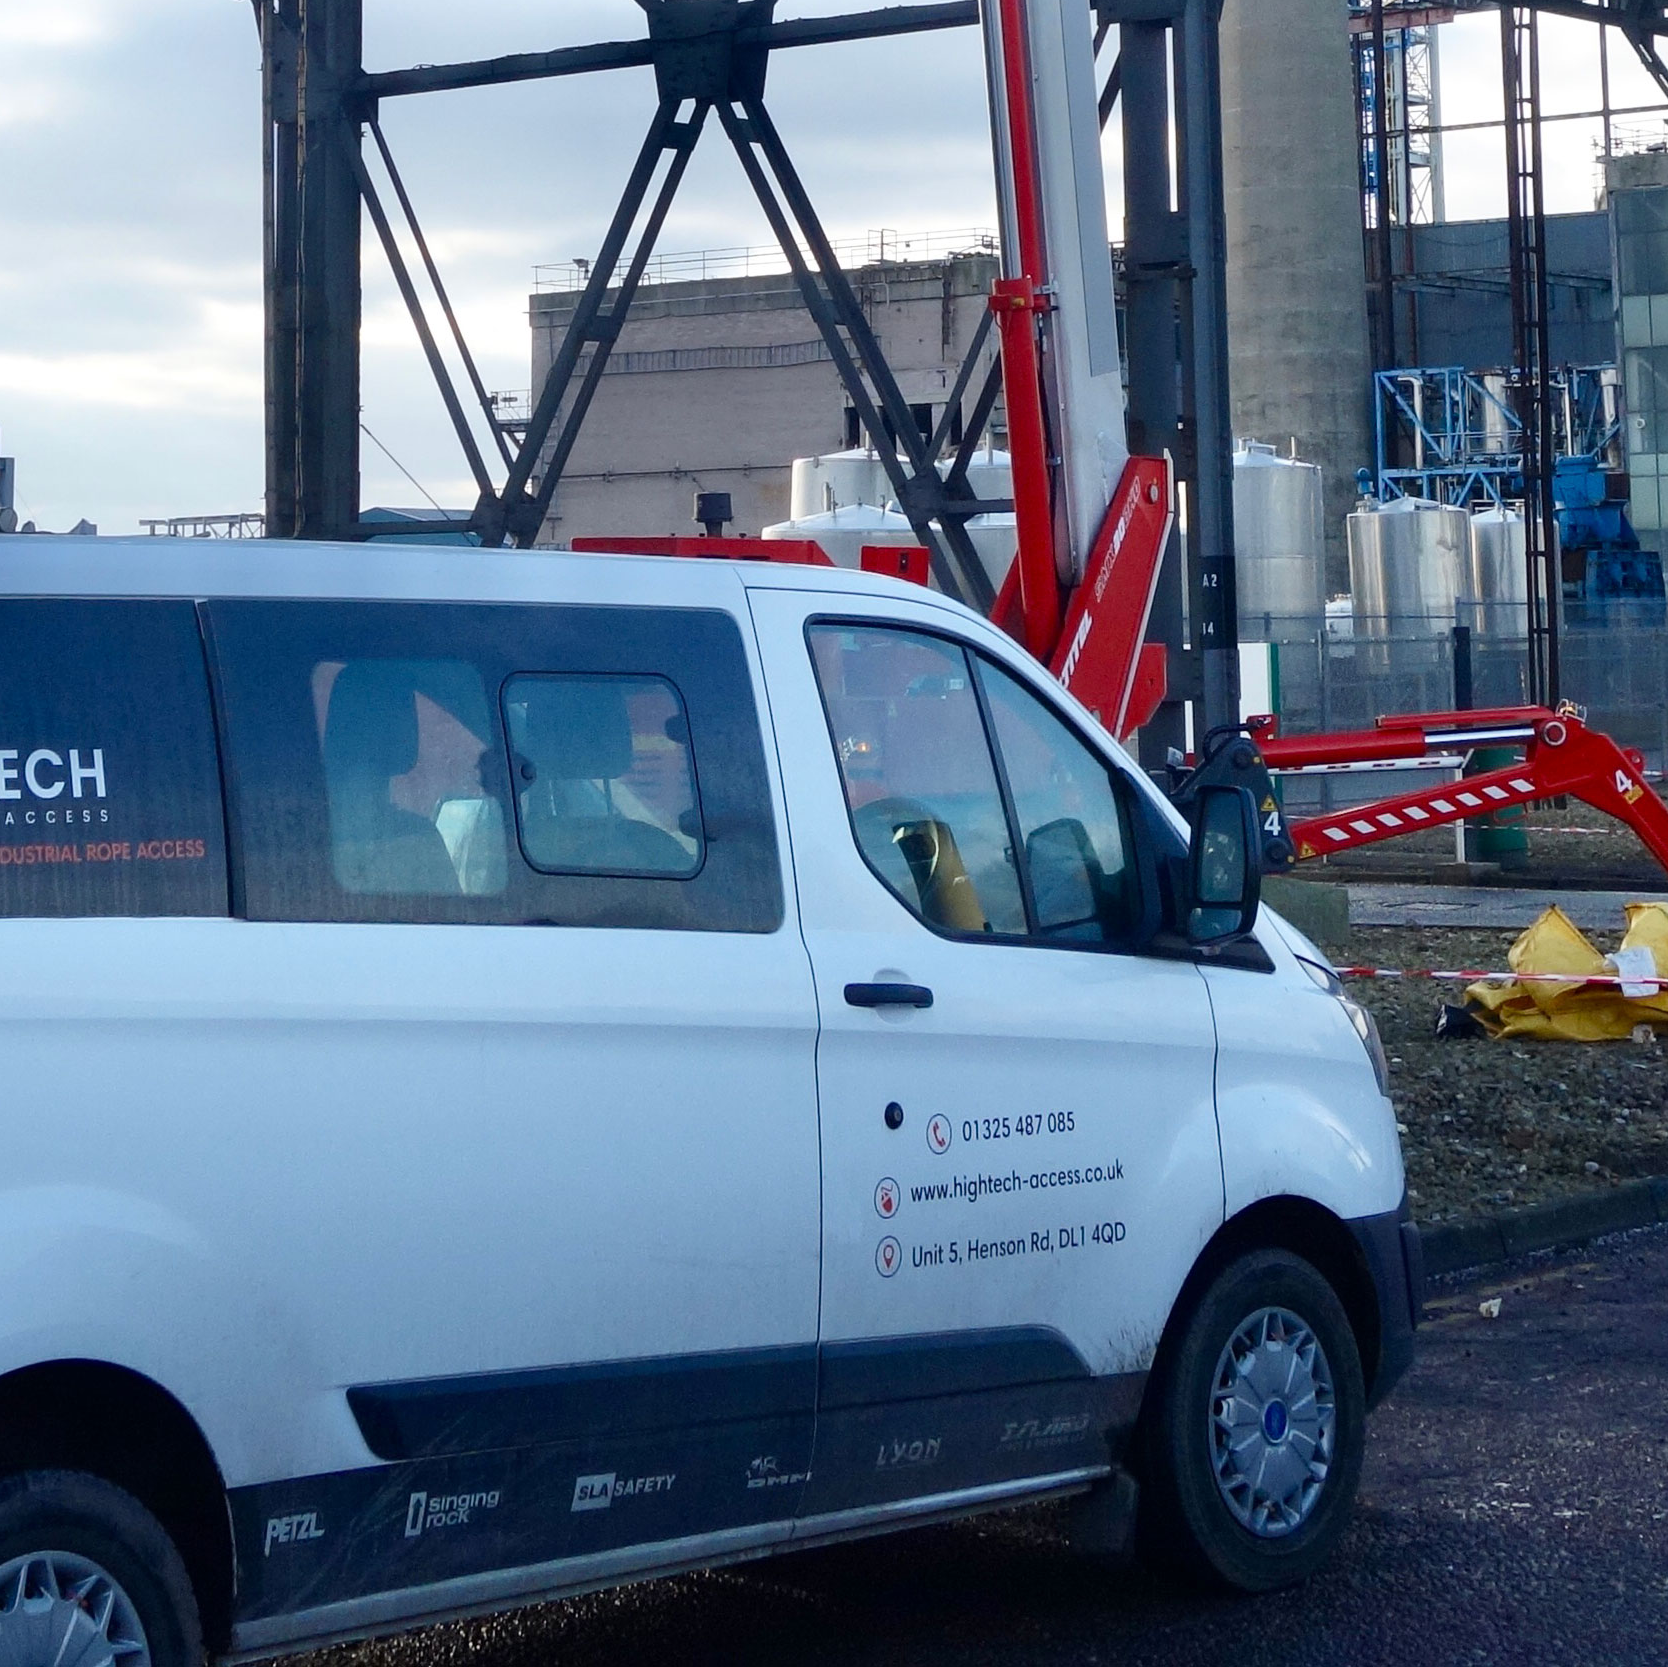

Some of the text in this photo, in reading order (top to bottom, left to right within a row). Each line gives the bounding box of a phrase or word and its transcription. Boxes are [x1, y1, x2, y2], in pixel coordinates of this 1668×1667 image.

[1615, 769, 1633, 793] 4
[5, 810, 110, 825] ACCESS
[1264, 811, 1281, 836] 4
[86, 842, 131, 862] ROPE
[136, 839, 205, 860] ACCESS
[962, 1111, 1075, 1142] 01325 487 085
[911, 1158, 1124, 1203] www.hightech-access.co.uk
[912, 1221, 1126, 1268] Unit 5, Henson Rd, DL1 4QD
[576, 1474, 676, 1501] SLA SAFETY
[428, 1490, 500, 1512] singing
[426, 1509, 470, 1529] rock
[264, 1511, 325, 1557] PETZL
